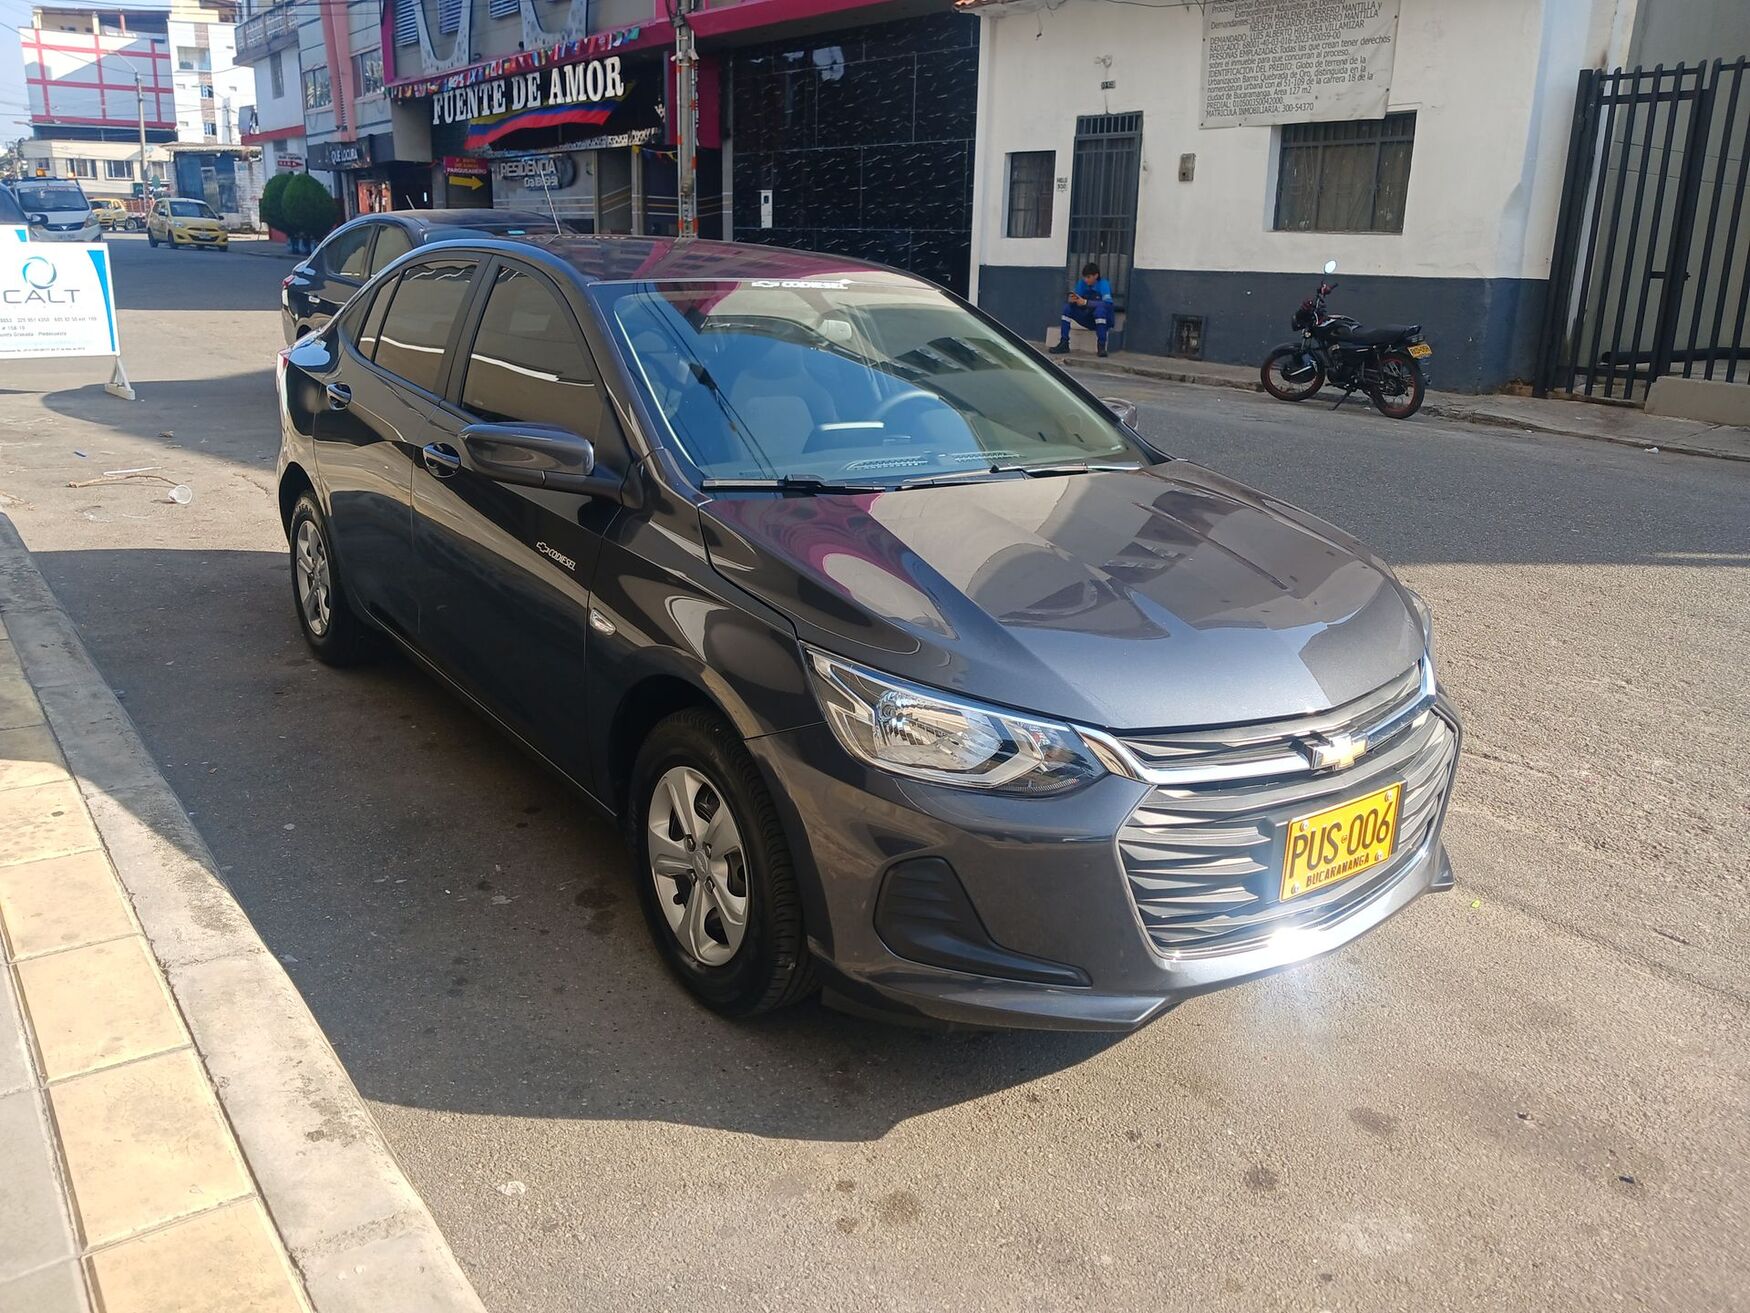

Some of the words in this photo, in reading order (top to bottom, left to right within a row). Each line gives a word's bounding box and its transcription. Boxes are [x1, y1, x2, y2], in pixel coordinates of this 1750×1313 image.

[1304, 5, 1340, 17] GUERRERO
[1341, 0, 1375, 13] MANTILLA
[1250, 21, 1272, 31] NELSON
[1274, 17, 1304, 29] EDUARDO
[1306, 13, 1342, 25] GUERRERO
[1344, 8, 1378, 20] MANTILLA
[1250, 31, 1263, 40] LUIS
[1264, 27, 1292, 38] ALBERTO
[1294, 24, 1322, 35] HIGUERA
[1324, 19, 1364, 31] VILLAMIZAR
[1209, 50, 1238, 61] PERSONAS
[1308, 42, 1320, 51] que
[1322, 40, 1339, 49] crean
[1341, 38, 1358, 47] tener
[1360, 33, 1391, 45] derechos
[1284, 51, 1314, 61] concurran
[1255, 64, 1266, 73] DEL
[1295, 59, 1312, 69] Globo
[1260, 71, 1288, 81] Quebrada
[432, 80, 506, 125] FUENTE
[512, 72, 541, 110] DE
[549, 56, 624, 105] AMOR
[1244, 81, 1262, 90] urbana
[1289, 86, 1299, 94] 127
[1301, 85, 1311, 93] m2
[3, 289, 80, 303] CALT
[548, 549, 576, 571] CODIESEL
[1305, 853, 1370, 887] BUCARAMANGA
